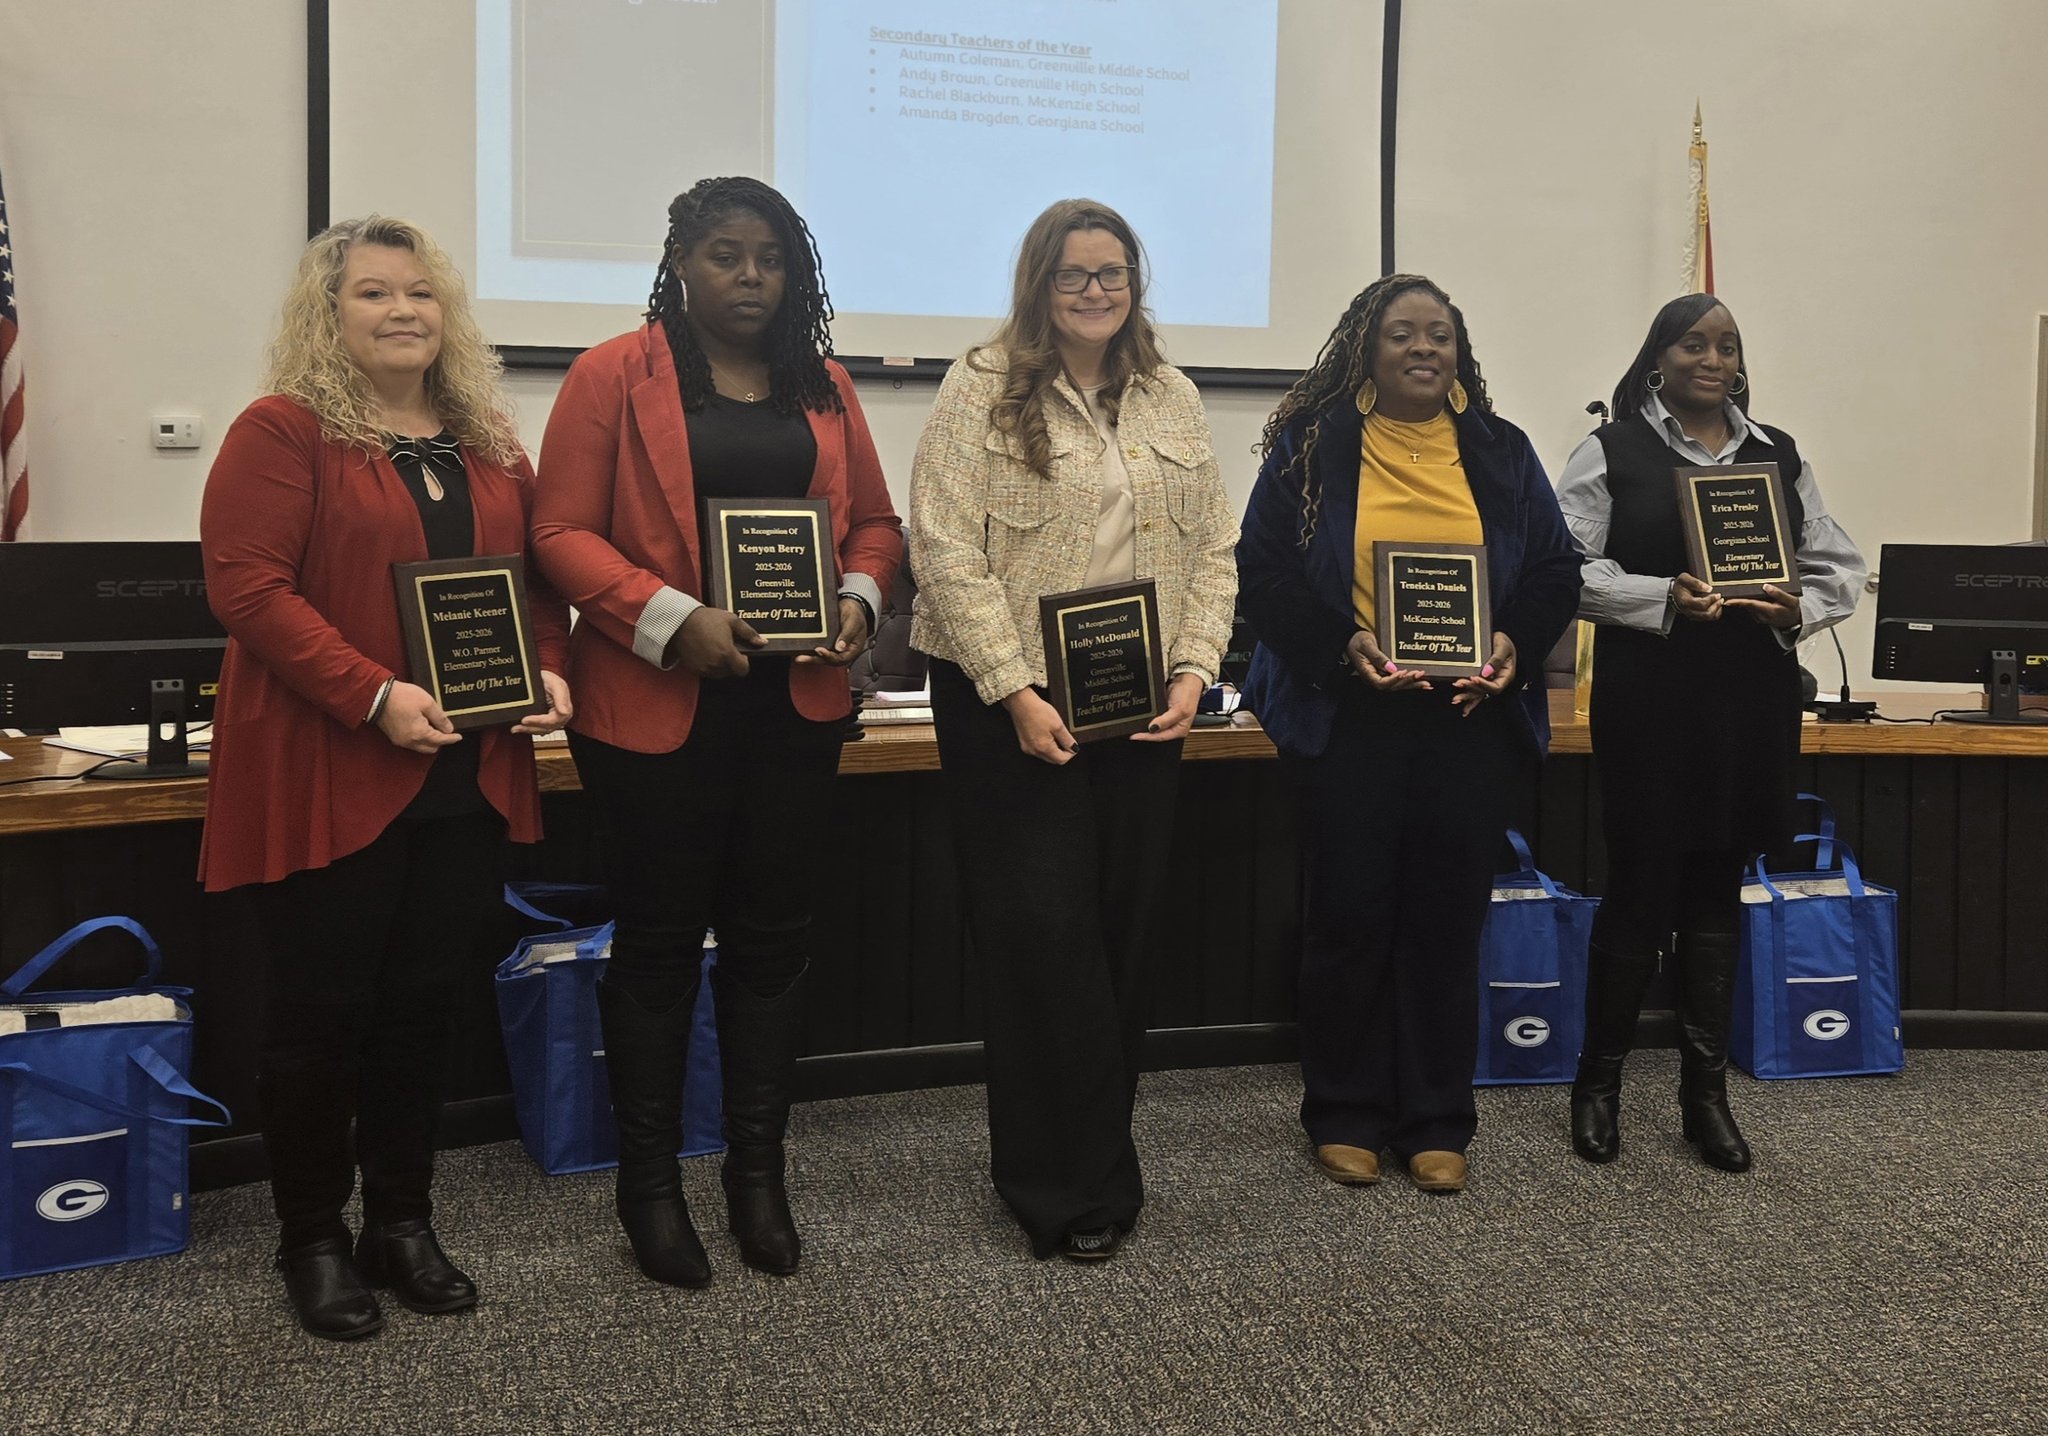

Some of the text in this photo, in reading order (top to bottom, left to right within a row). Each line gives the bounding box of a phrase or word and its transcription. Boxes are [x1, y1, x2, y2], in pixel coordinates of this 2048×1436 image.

[869, 26, 1093, 55] Secondary Teachers of the Year
[900, 48, 955, 63] Autumn
[1028, 58, 1095, 74] Greenville
[1099, 64, 1143, 78] Middle
[1146, 67, 1191, 81] School
[900, 67, 936, 84] Andy
[994, 75, 1062, 90] Greenville
[1066, 80, 1096, 96] High
[1100, 83, 1144, 96] School
[900, 86, 946, 101] Rachel
[1028, 96, 1093, 111] McKenzie
[1096, 100, 1140, 114] School
[900, 106, 957, 121] Amanda
[1028, 115, 1097, 132] Georgiana
[1100, 120, 1144, 134] School
[1712, 504, 1759, 513] Erica Presley
[1713, 535, 1770, 546] Georgiana School
[739, 544, 805, 555] Kenyon Berry
[755, 563, 792, 571] 2025-2026
[1713, 561, 1780, 573] Teacher Of The Year
[755, 579, 795, 587] Greenville
[1400, 581, 1467, 592] Teneicka Daniels
[448, 592, 484, 600] Recognition
[740, 590, 811, 600] Elementary School
[1417, 600, 1451, 608] 2025-2026
[432, 607, 507, 622] Melanie Keener
[738, 609, 817, 620] Teacher Of The Year
[1403, 615, 1466, 625] McKenzie School
[456, 628, 493, 640] 2025-2026
[1071, 629, 1140, 649] Holly McDonald
[1414, 632, 1457, 643] Elementary
[452, 648, 472, 657] W.O.
[1399, 642, 1472, 653] Teacher Of The Year
[1090, 649, 1123, 660] 2025-2026
[444, 655, 515, 672] Elementary School
[1090, 664, 1126, 676] Greenville
[444, 676, 522, 694] Teacher Of The Year
[1085, 673, 1134, 688] Middle School
[1090, 690, 1132, 703] Elementary
[1077, 697, 1148, 717] Teacher Of The Year
[1803, 1009, 1850, 1041] G
[1504, 1016, 1550, 1047] G
[36, 1179, 109, 1222] G
